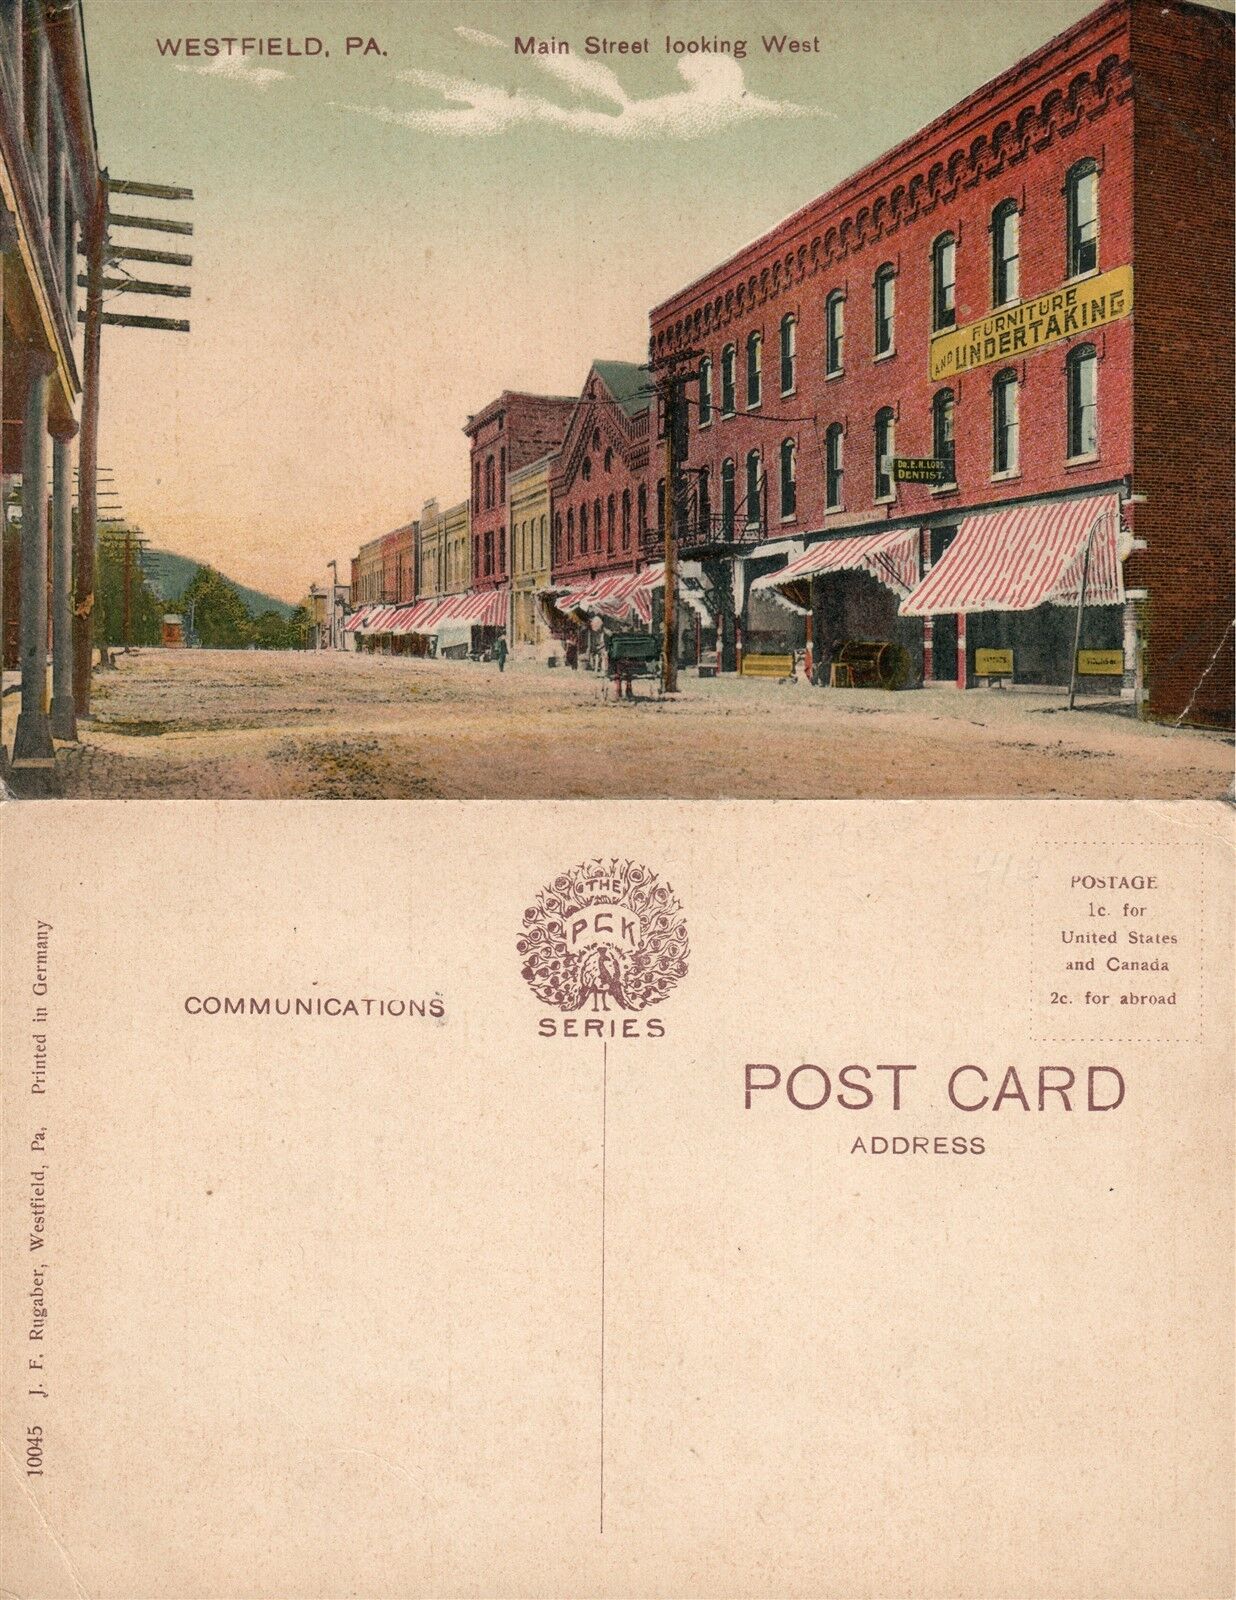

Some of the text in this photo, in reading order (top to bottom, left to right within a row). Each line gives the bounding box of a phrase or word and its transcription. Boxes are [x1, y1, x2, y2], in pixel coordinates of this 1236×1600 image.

[972, 288, 1077, 342] FURNITURE
[955, 289, 1125, 371] UNDERTAKING
[585, 879, 622, 894] THE
[1070, 875, 1158, 890] POSTAGE
[1088, 902, 1147, 917] 1c. for
[1061, 930, 1178, 945] United States
[32, 920, 54, 997] Germany
[1065, 956, 1170, 972] and Canada
[184, 995, 446, 1018] COMMUNICATIONS
[1050, 990, 1177, 1006] 2c. for abroad
[32, 1007, 48, 1023] in
[538, 1017, 666, 1038] SERIES
[31, 1033, 47, 1095] Printed
[744, 1064, 1126, 1112] POST CARD
[850, 1136, 986, 1156] ADDRESS
[29, 1164, 49, 1252] Westfield,
[28, 1263, 49, 1341] Rugaber,
[28, 1352, 45, 1370] F.
[28, 1382, 49, 1399] J.
[26, 1425, 44, 1477] 10045
